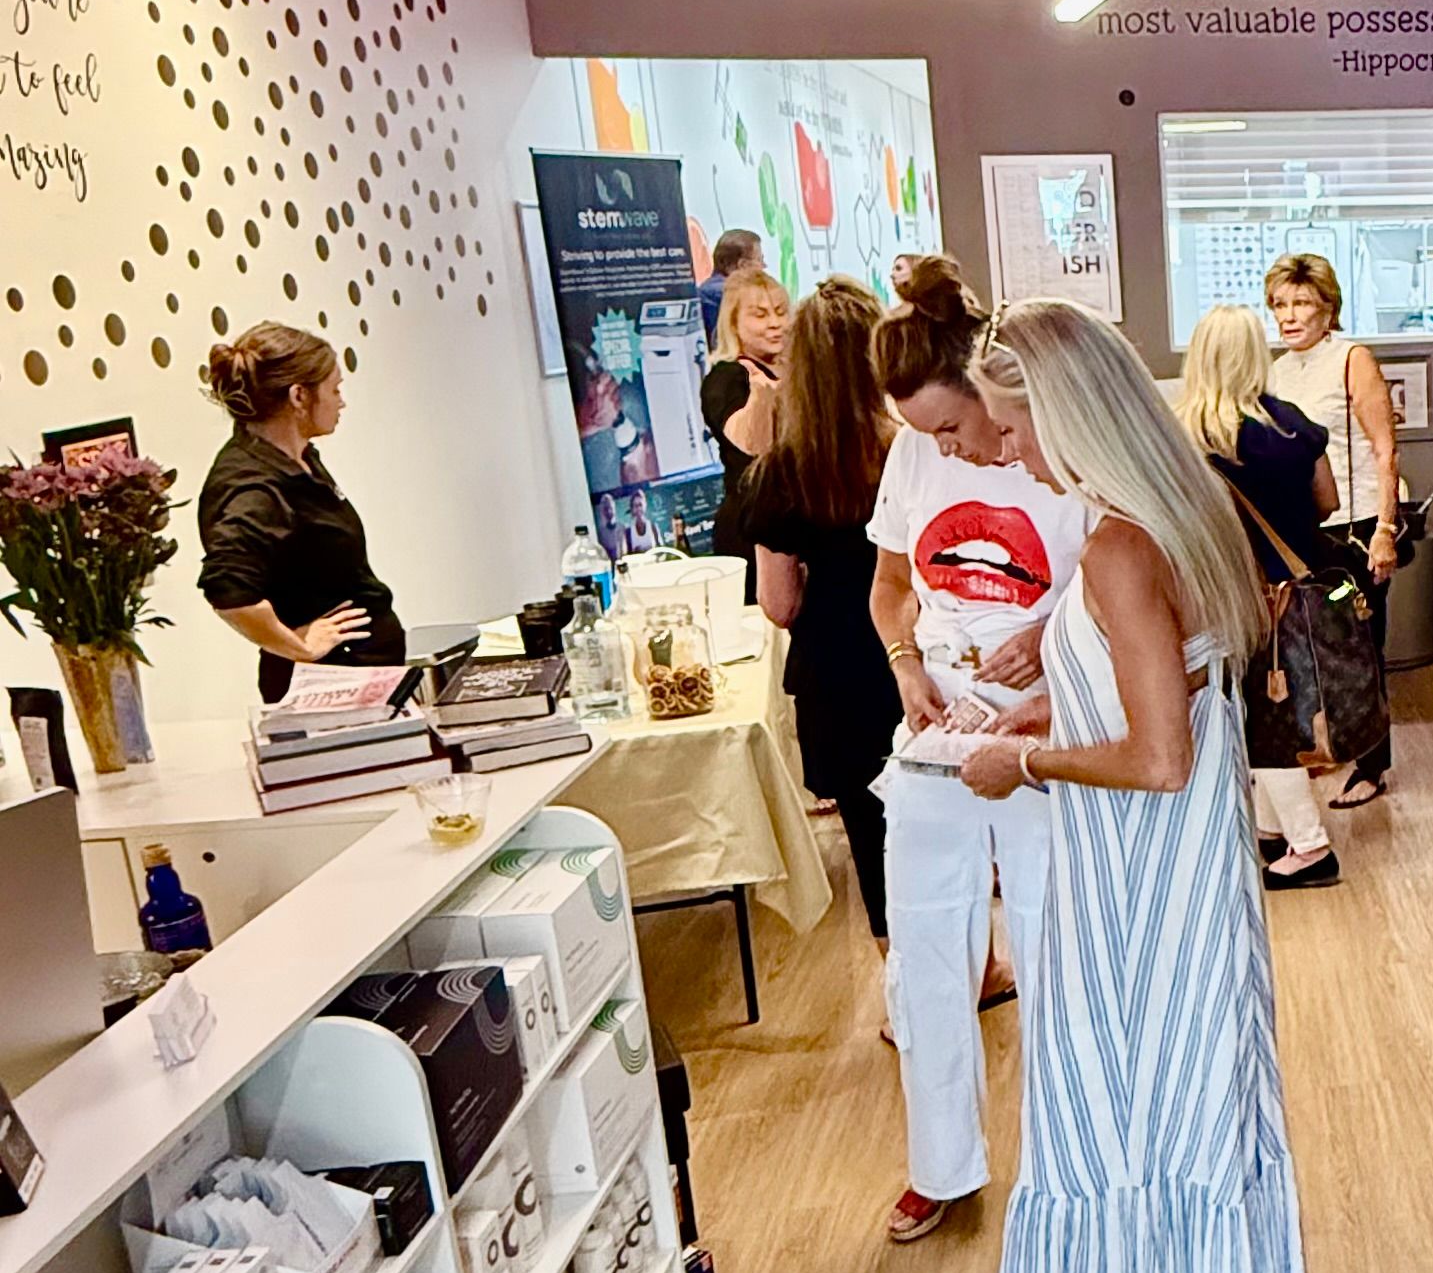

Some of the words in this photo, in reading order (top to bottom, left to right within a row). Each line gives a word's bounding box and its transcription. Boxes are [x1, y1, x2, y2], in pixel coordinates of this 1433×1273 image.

[1097, 9, 1177, 35] most
[1186, 6, 1316, 35] valuable
[0, 51, 43, 98] to
[53, 52, 101, 116] feel
[0, 134, 88, 203] azing
[577, 208, 661, 228] stemwave
